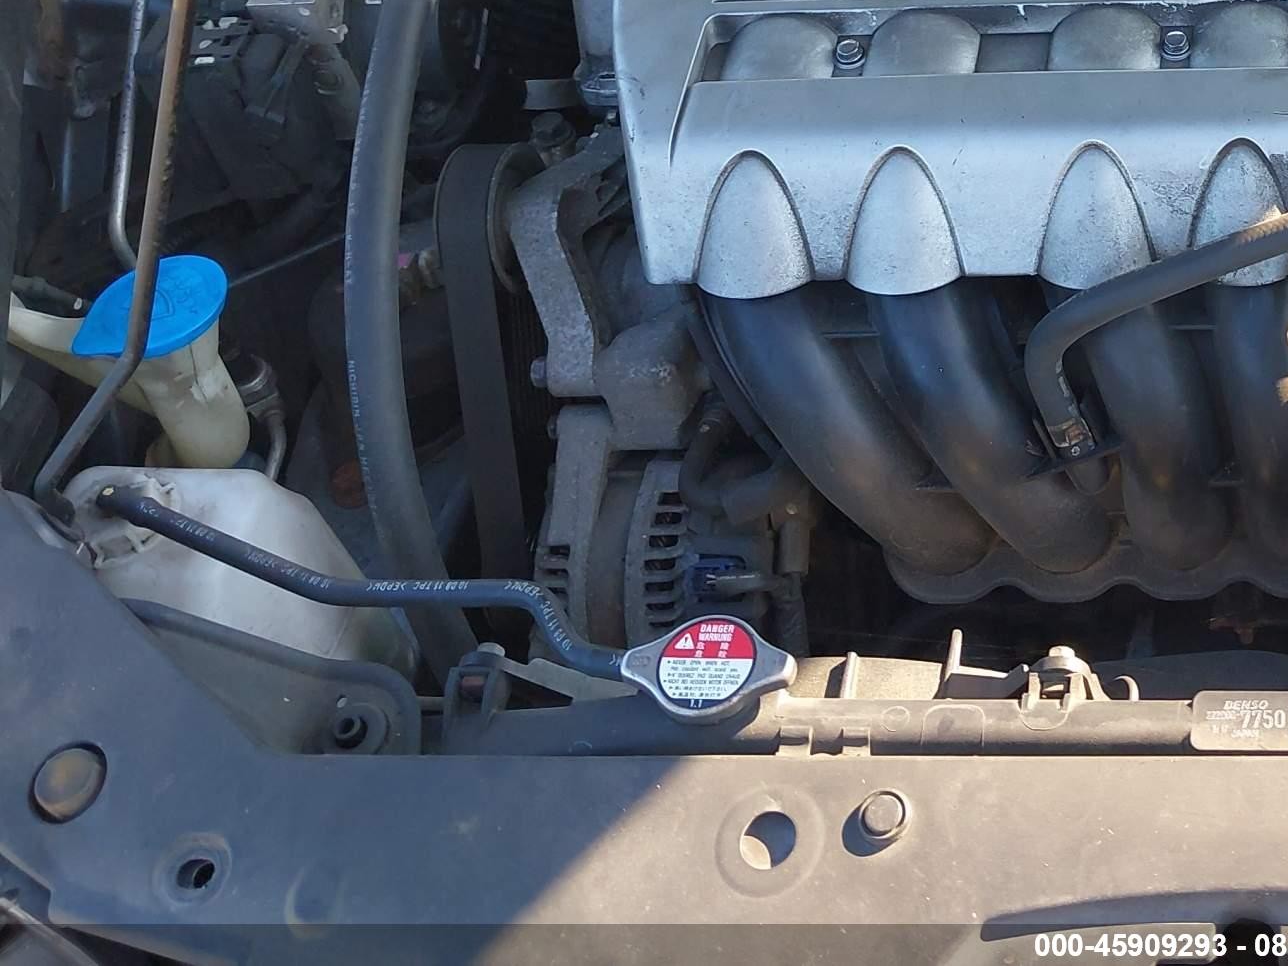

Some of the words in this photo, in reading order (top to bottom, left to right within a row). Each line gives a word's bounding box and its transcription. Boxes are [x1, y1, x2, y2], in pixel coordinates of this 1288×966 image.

[700, 624, 734, 633] DANGER
[690, 699, 703, 708] 1.1
[1223, 699, 1269, 710] DENSO
